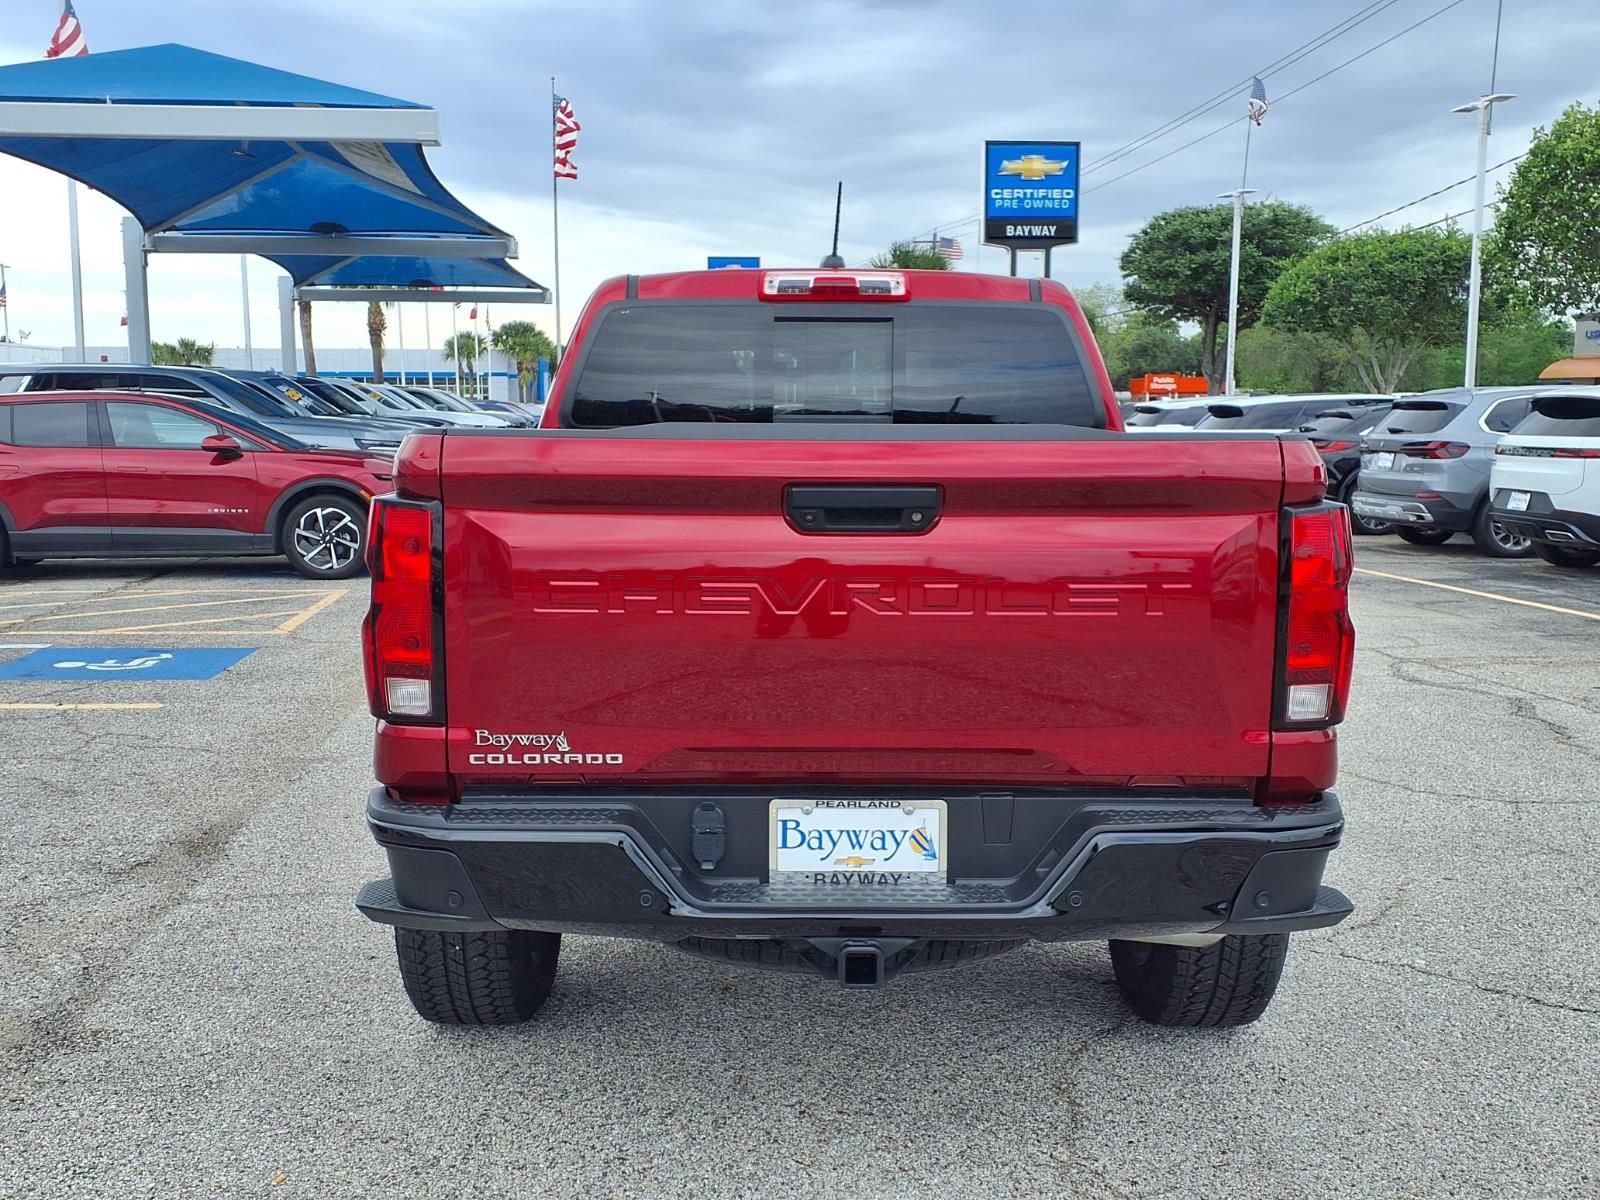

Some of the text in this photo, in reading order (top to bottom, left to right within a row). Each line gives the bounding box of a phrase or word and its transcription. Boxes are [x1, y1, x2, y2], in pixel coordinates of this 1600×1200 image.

[991, 189, 1075, 199] CERTIFIED
[995, 200, 1070, 209] PRE-OWNED
[1006, 225, 1057, 236] BAYWAY
[533, 577, 1192, 616] CHEVROLET
[475, 729, 557, 751] Bayway
[469, 754, 624, 765] COLORADO
[815, 800, 901, 809] PEARLAND
[777, 819, 909, 862] Bayway
